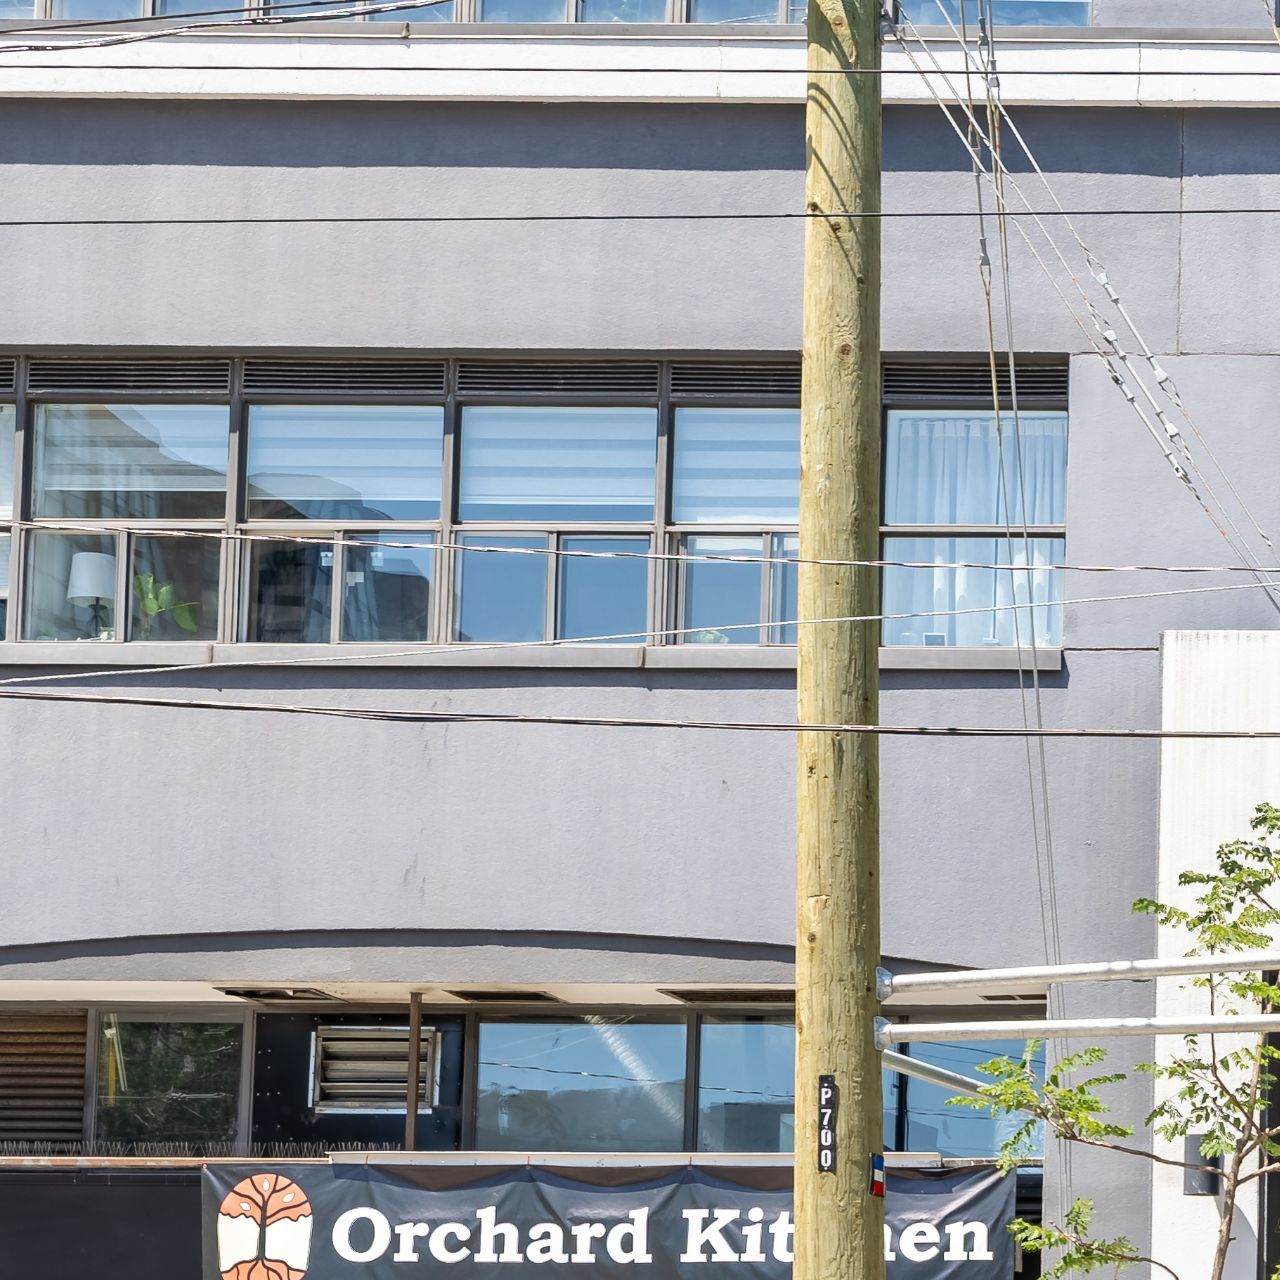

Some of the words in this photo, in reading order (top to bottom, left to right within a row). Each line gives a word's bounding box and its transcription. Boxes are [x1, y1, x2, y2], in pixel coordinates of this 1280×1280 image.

[819, 1086, 833, 1171] P700
[332, 1205, 652, 1263] Orchard
[680, 1207, 993, 1263] Kiten
